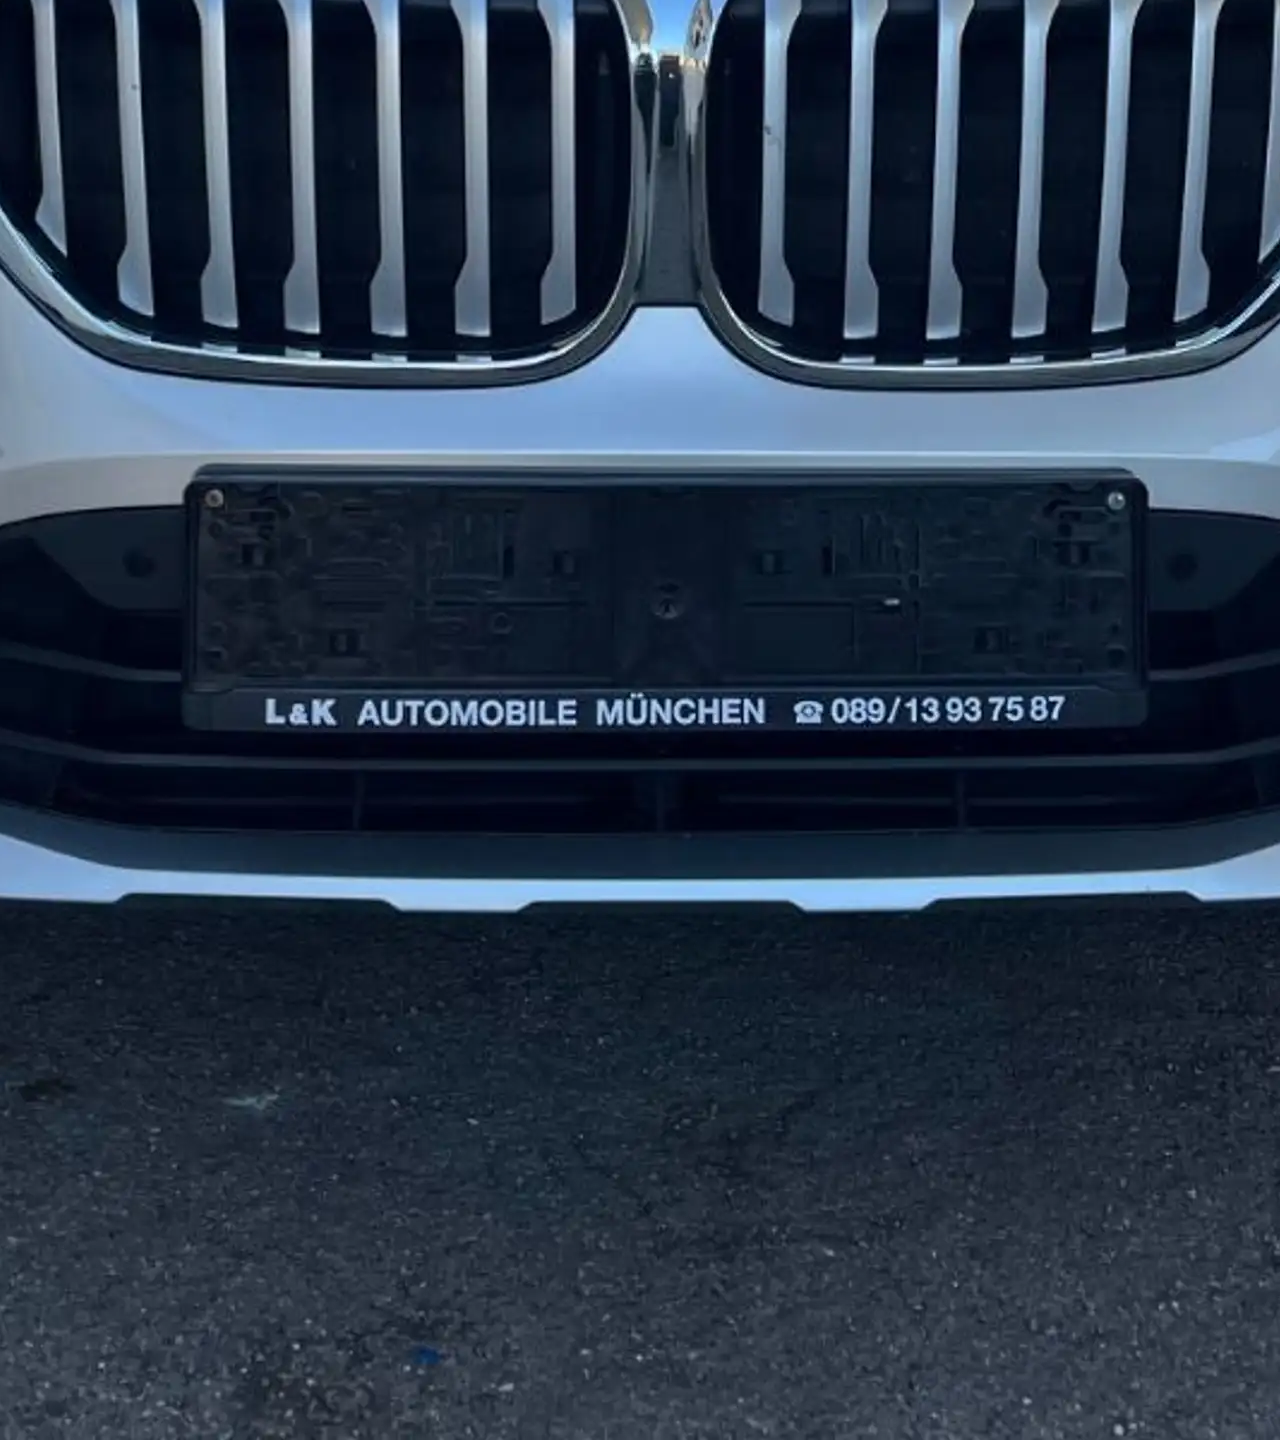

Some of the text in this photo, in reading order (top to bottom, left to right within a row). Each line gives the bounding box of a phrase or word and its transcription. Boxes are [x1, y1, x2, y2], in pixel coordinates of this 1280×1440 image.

[265, 698, 337, 726] L&K
[357, 698, 578, 727] AUTOMOBILE
[596, 692, 765, 726] MÜNCHEN
